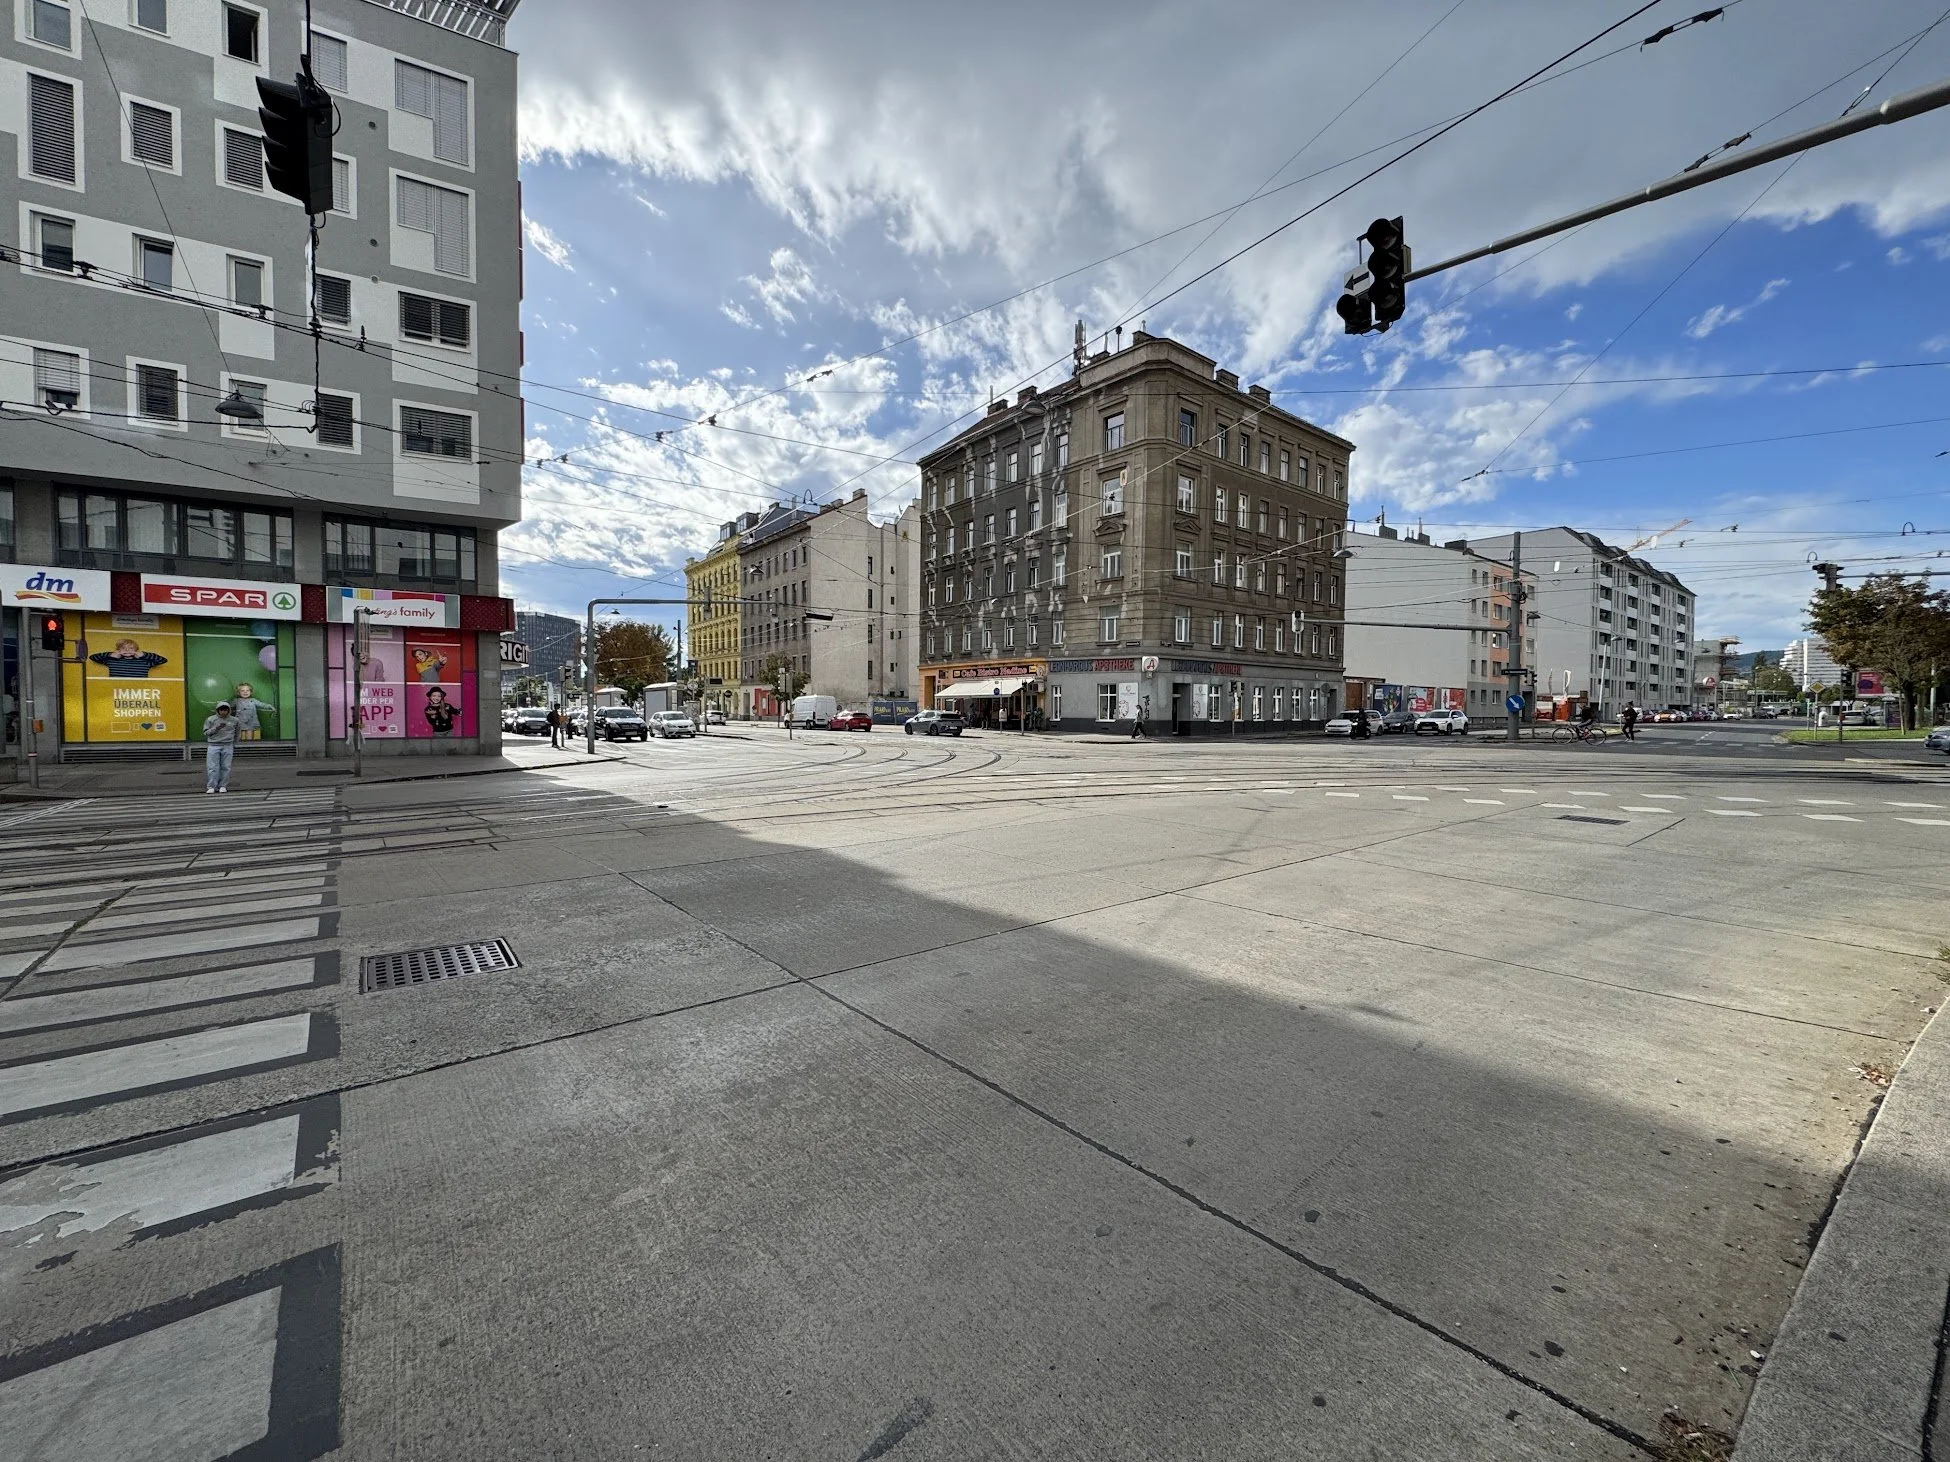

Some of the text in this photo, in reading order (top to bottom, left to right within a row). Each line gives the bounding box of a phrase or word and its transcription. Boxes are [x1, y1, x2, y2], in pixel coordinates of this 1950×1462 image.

[26, 572, 74, 592] dm
[170, 589, 265, 605] SPAR
[400, 606, 435, 619] family
[1094, 659, 1134, 671] APOTHEKE
[113, 689, 161, 700] IMMER
[372, 688, 394, 697] WEB
[114, 699, 161, 709] ÜBERALL
[113, 709, 161, 717] SHOPPEN
[360, 706, 394, 720] APP
